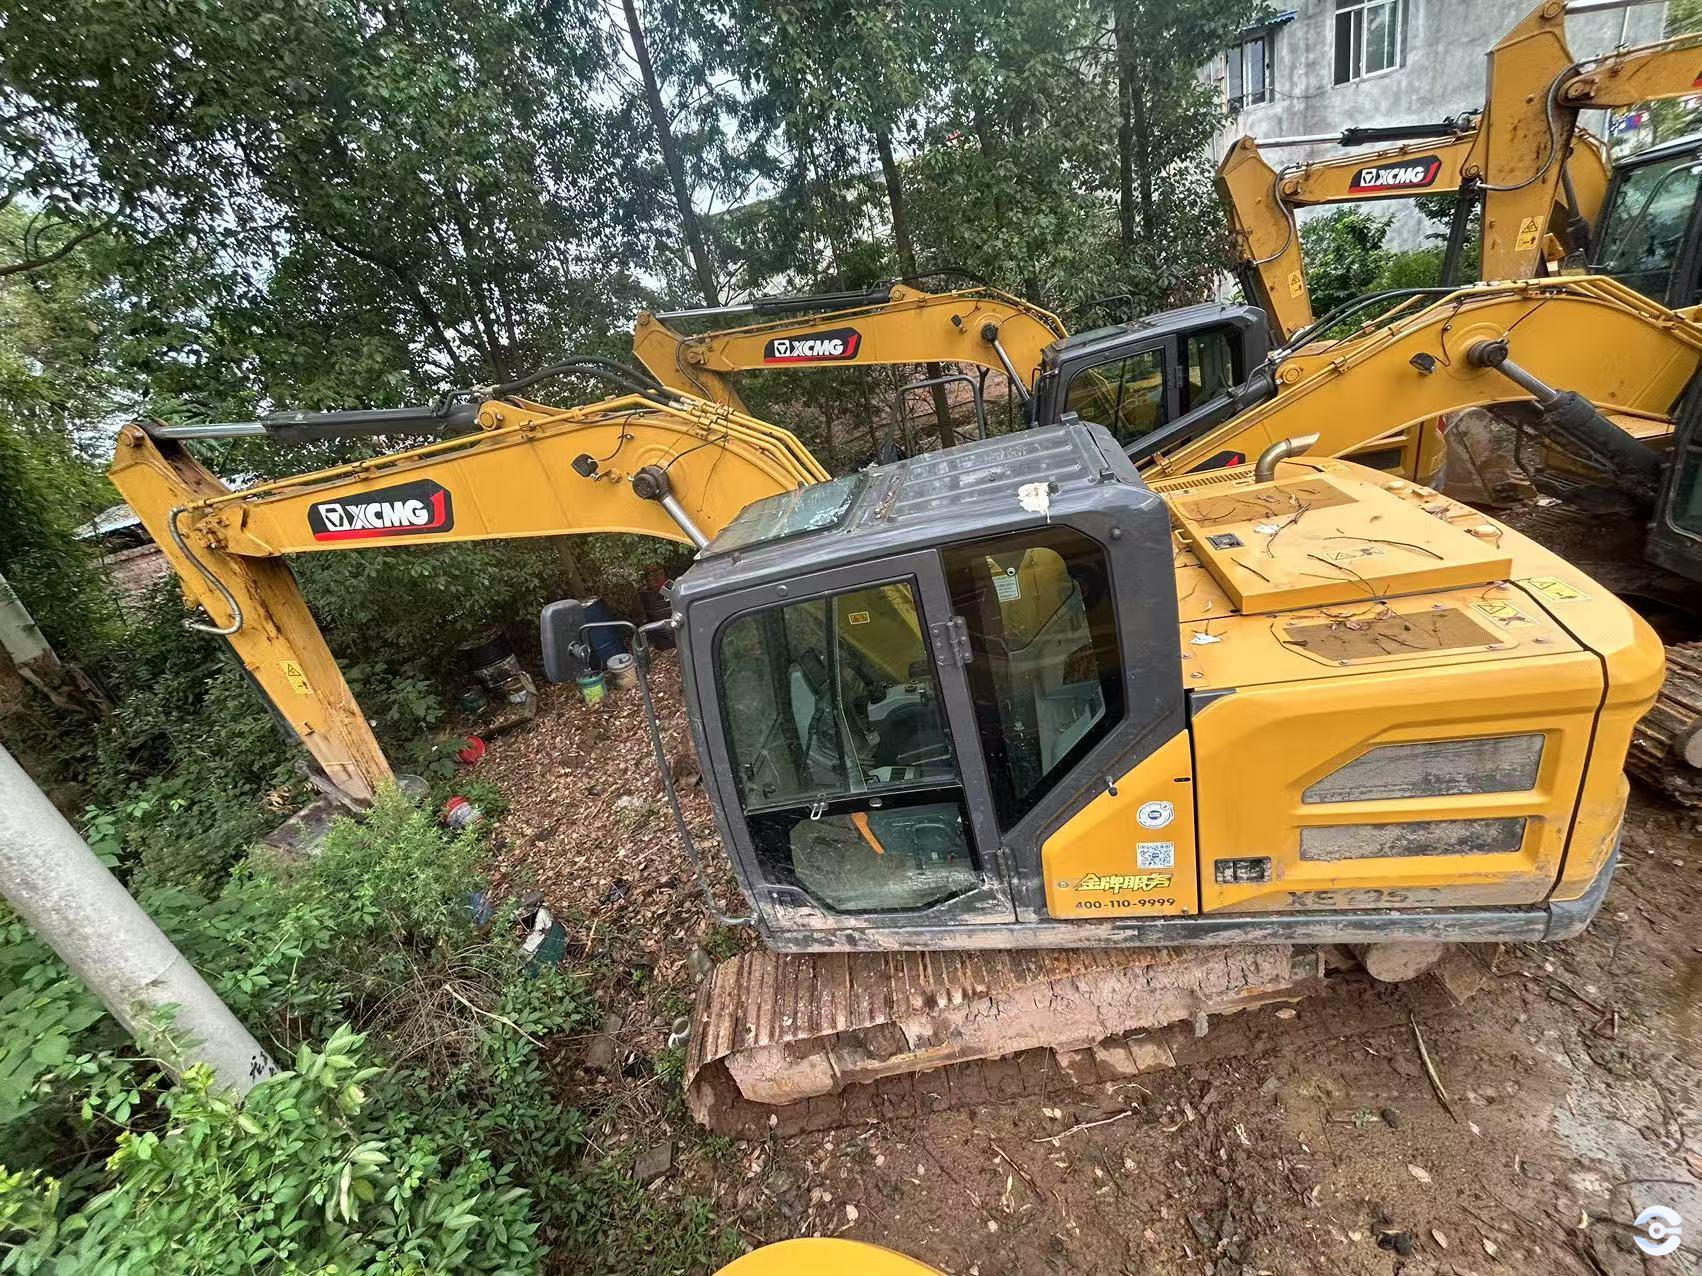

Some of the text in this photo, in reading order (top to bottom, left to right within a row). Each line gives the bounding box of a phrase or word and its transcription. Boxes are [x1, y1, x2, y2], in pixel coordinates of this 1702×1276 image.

[1374, 166, 1424, 186] XCMG
[790, 339, 844, 357] XCMG
[345, 499, 429, 530] XCMG
[1074, 872, 1174, 894] 金牌服务
[1075, 898, 1176, 909] 400-110-9999
